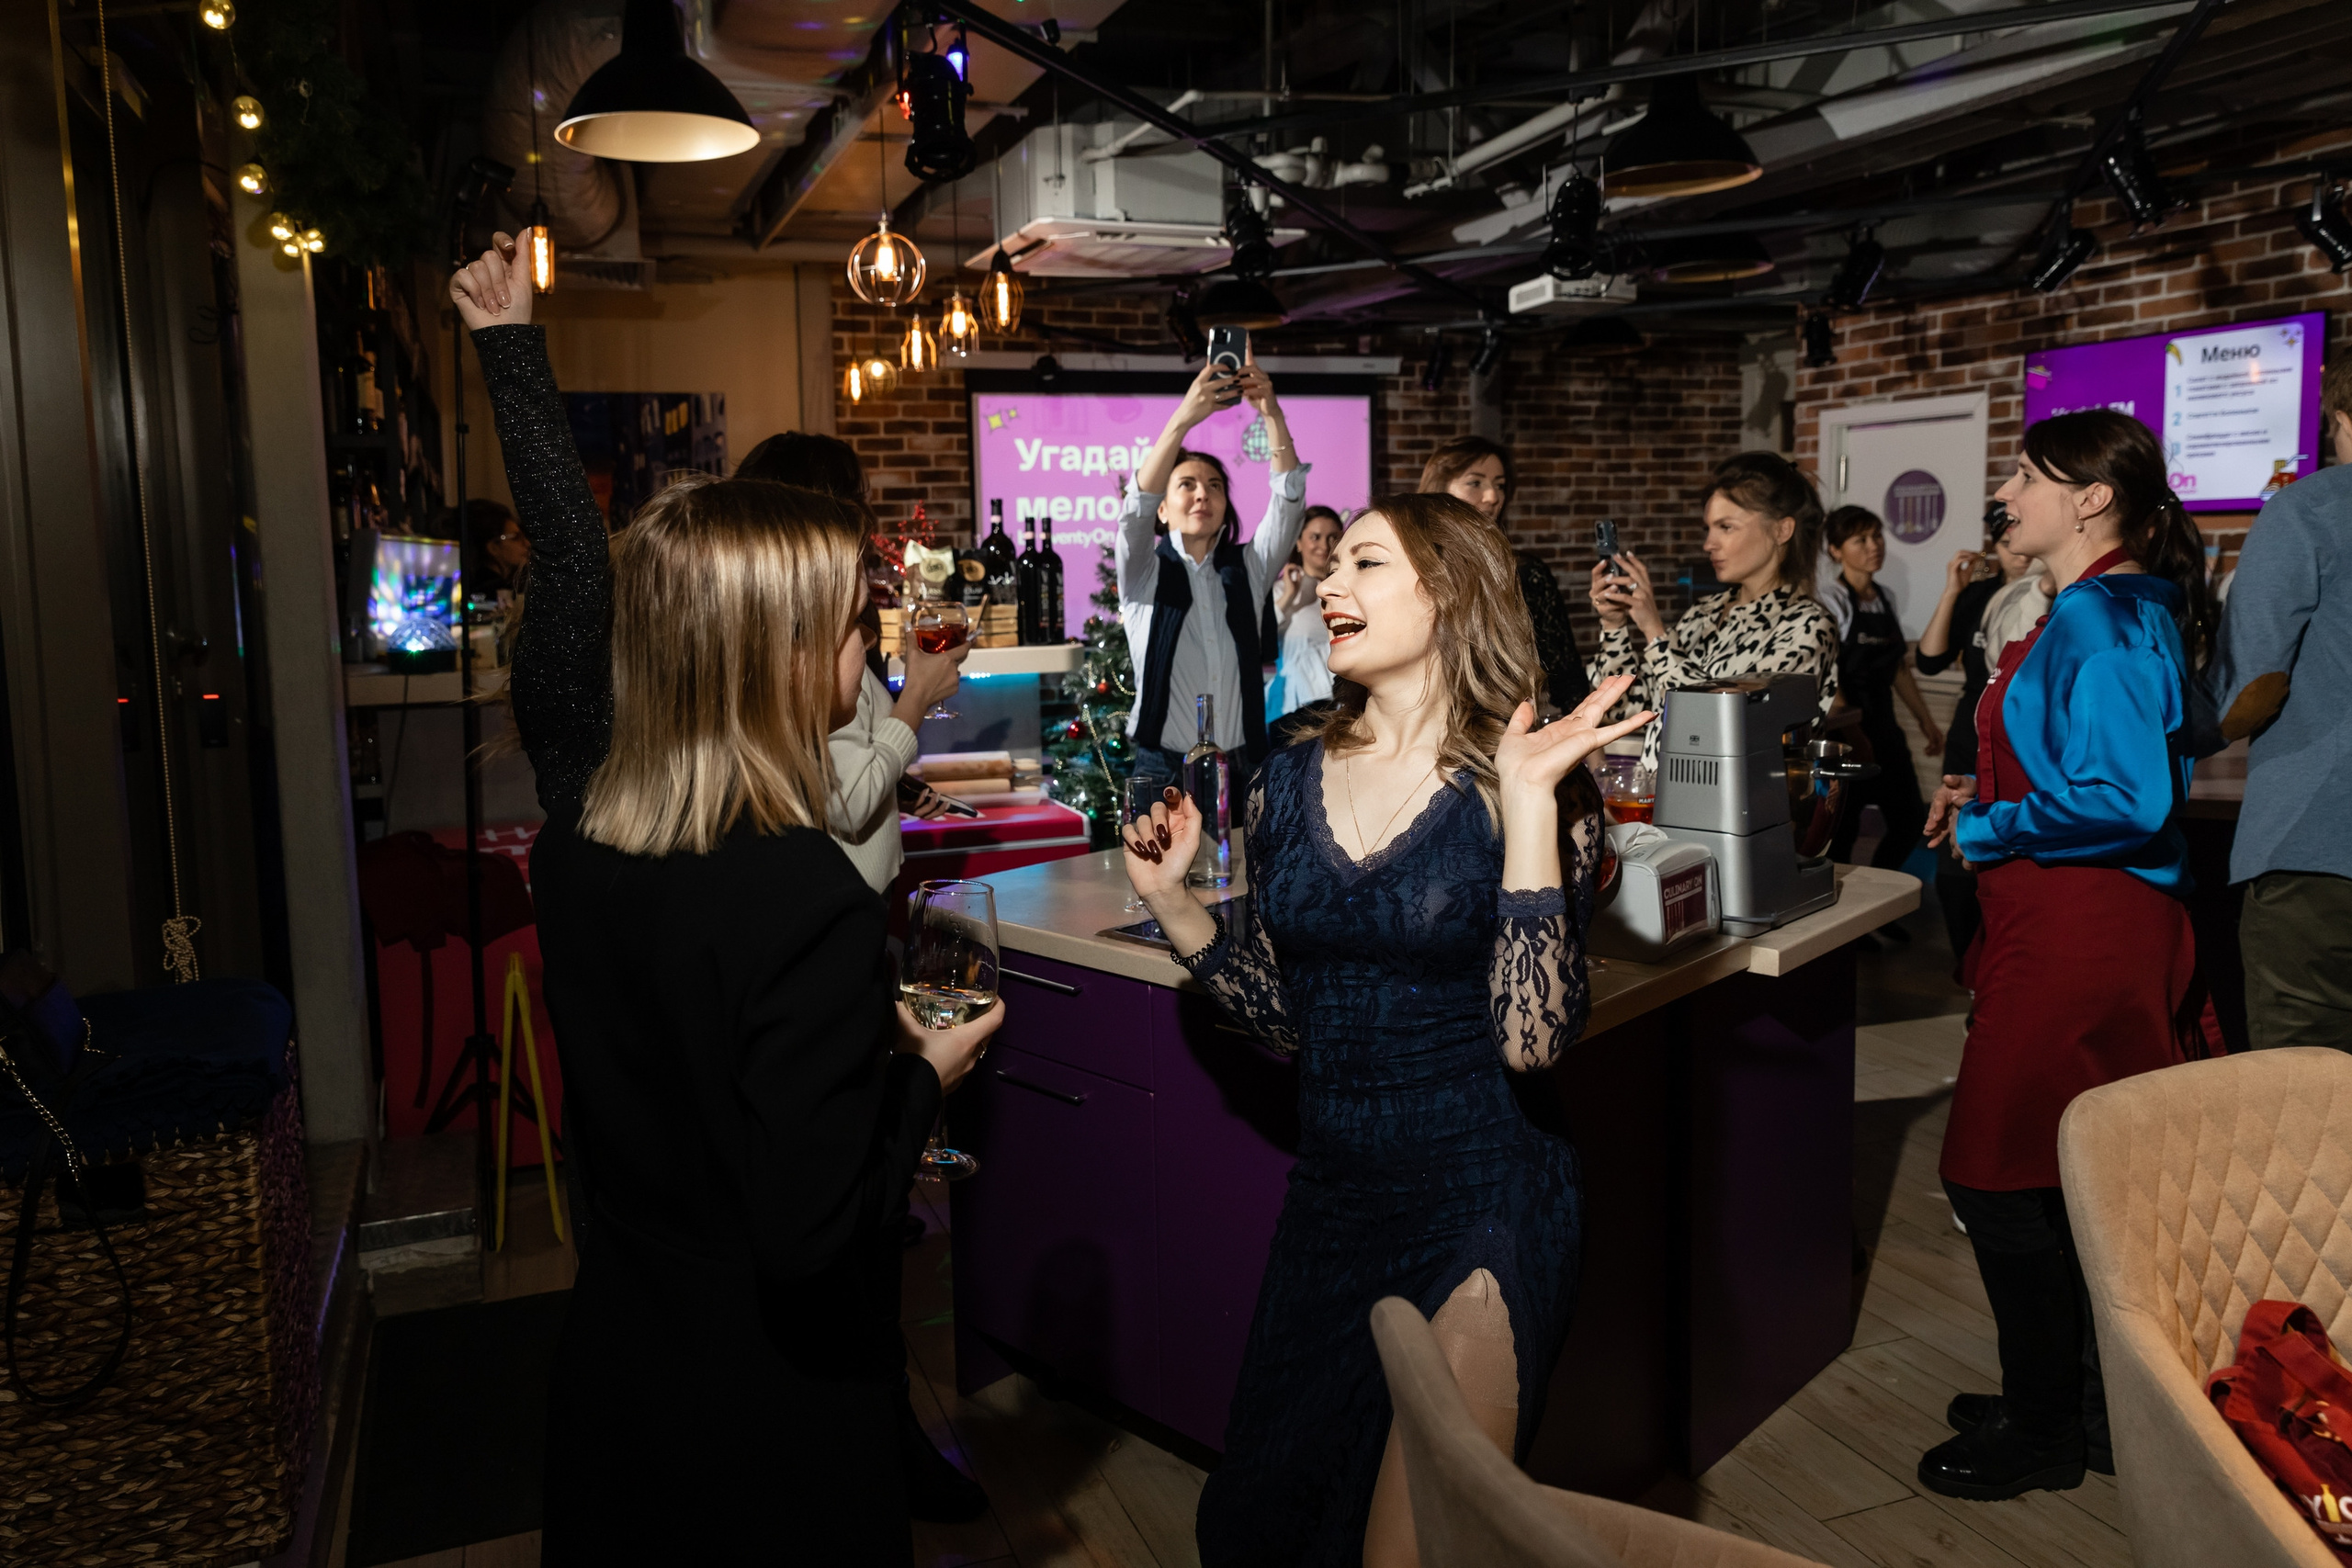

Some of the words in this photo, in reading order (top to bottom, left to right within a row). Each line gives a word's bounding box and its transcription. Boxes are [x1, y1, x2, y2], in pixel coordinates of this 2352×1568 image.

[2200, 344, 2261, 365] Меню
[2175, 384, 2182, 397] 1
[2172, 412, 2182, 426] 2
[1013, 436, 1154, 477] Угадай
[1016, 495, 1121, 522] мело
[1051, 527, 1114, 548] ventyOn
[1663, 878, 1693, 899] CULINARY
[1693, 874, 1702, 887] ON
